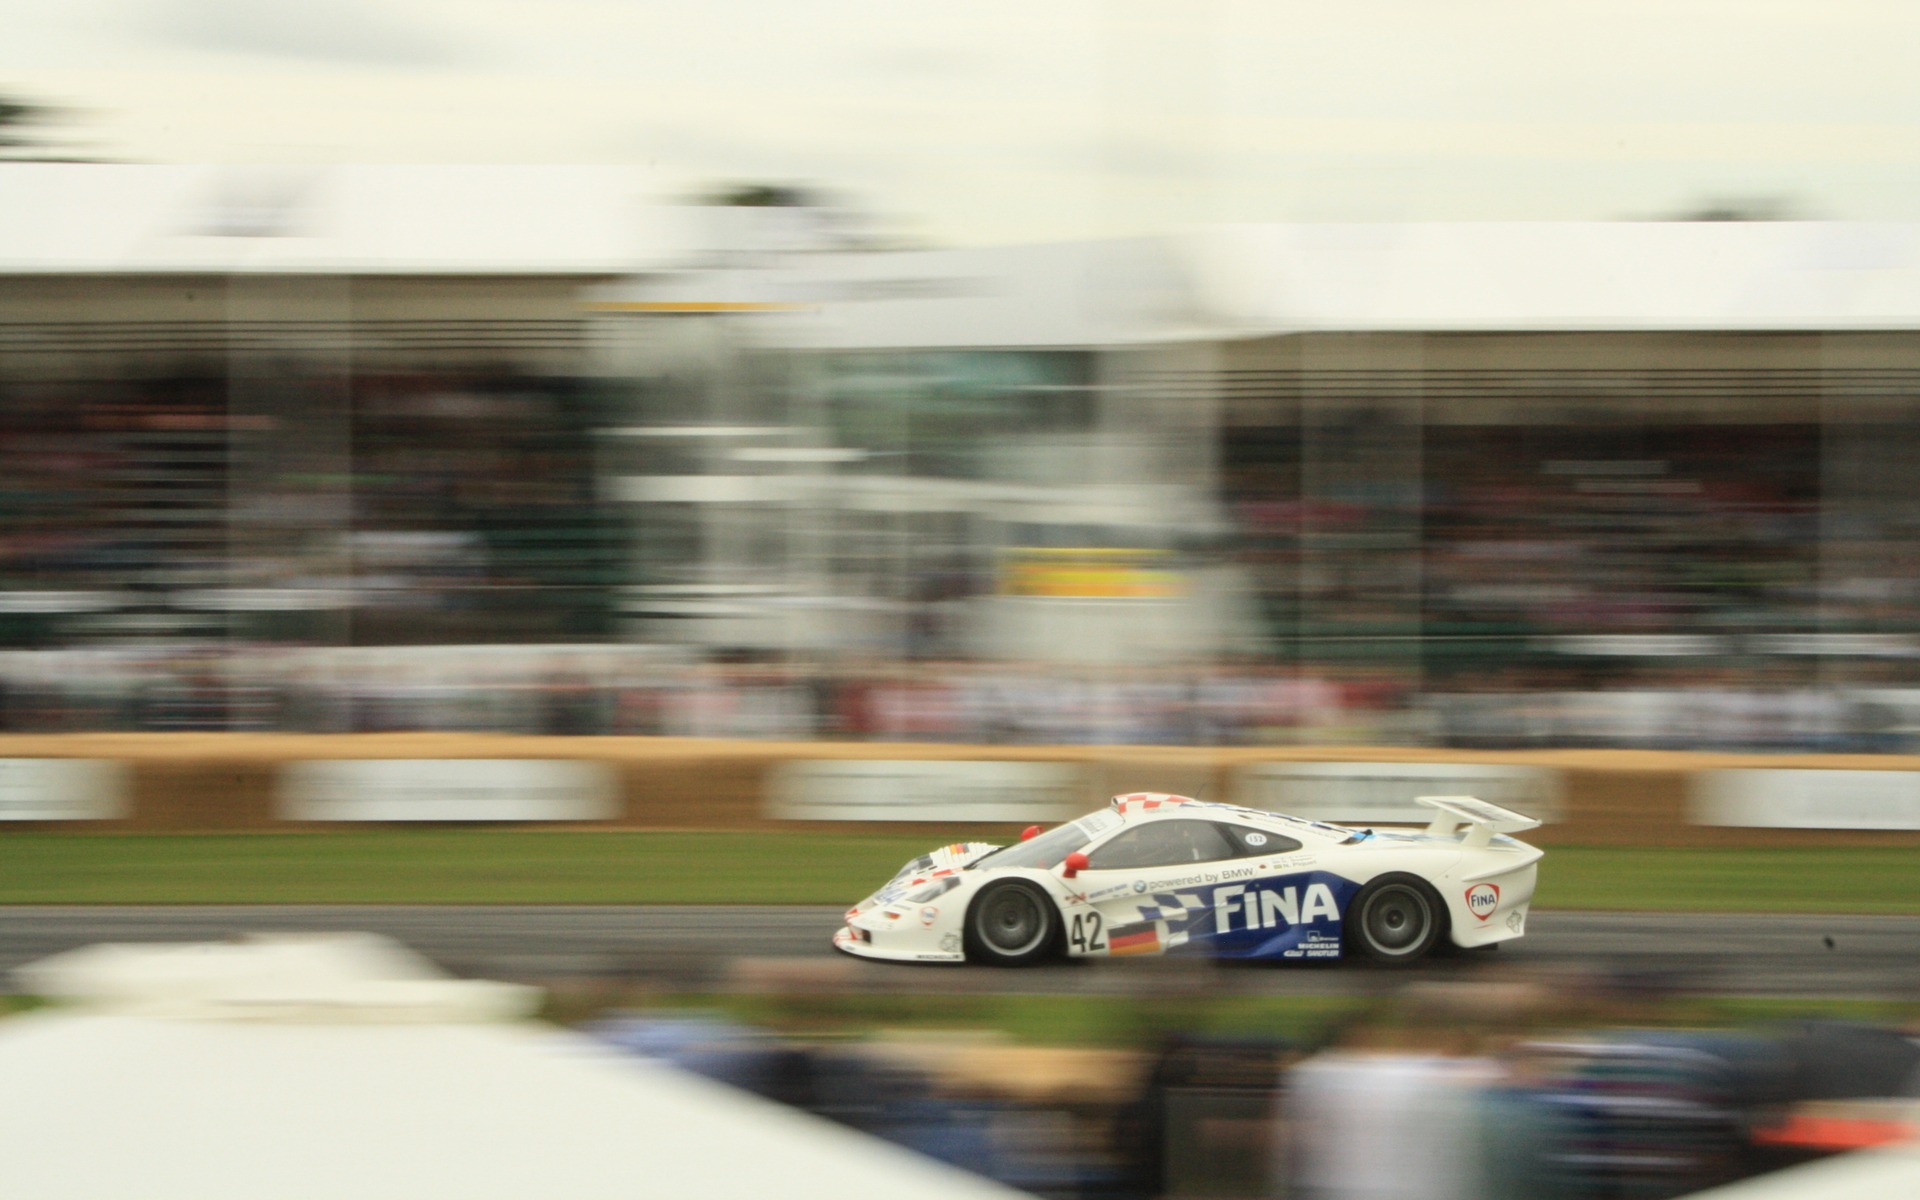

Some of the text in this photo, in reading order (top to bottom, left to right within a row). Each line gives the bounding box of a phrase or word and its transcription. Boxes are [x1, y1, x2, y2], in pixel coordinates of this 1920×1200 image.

[1149, 867, 1254, 890] powered by BMW
[1213, 883, 1341, 934] FINA
[1470, 894, 1496, 907] FINA
[1071, 911, 1105, 952] 42
